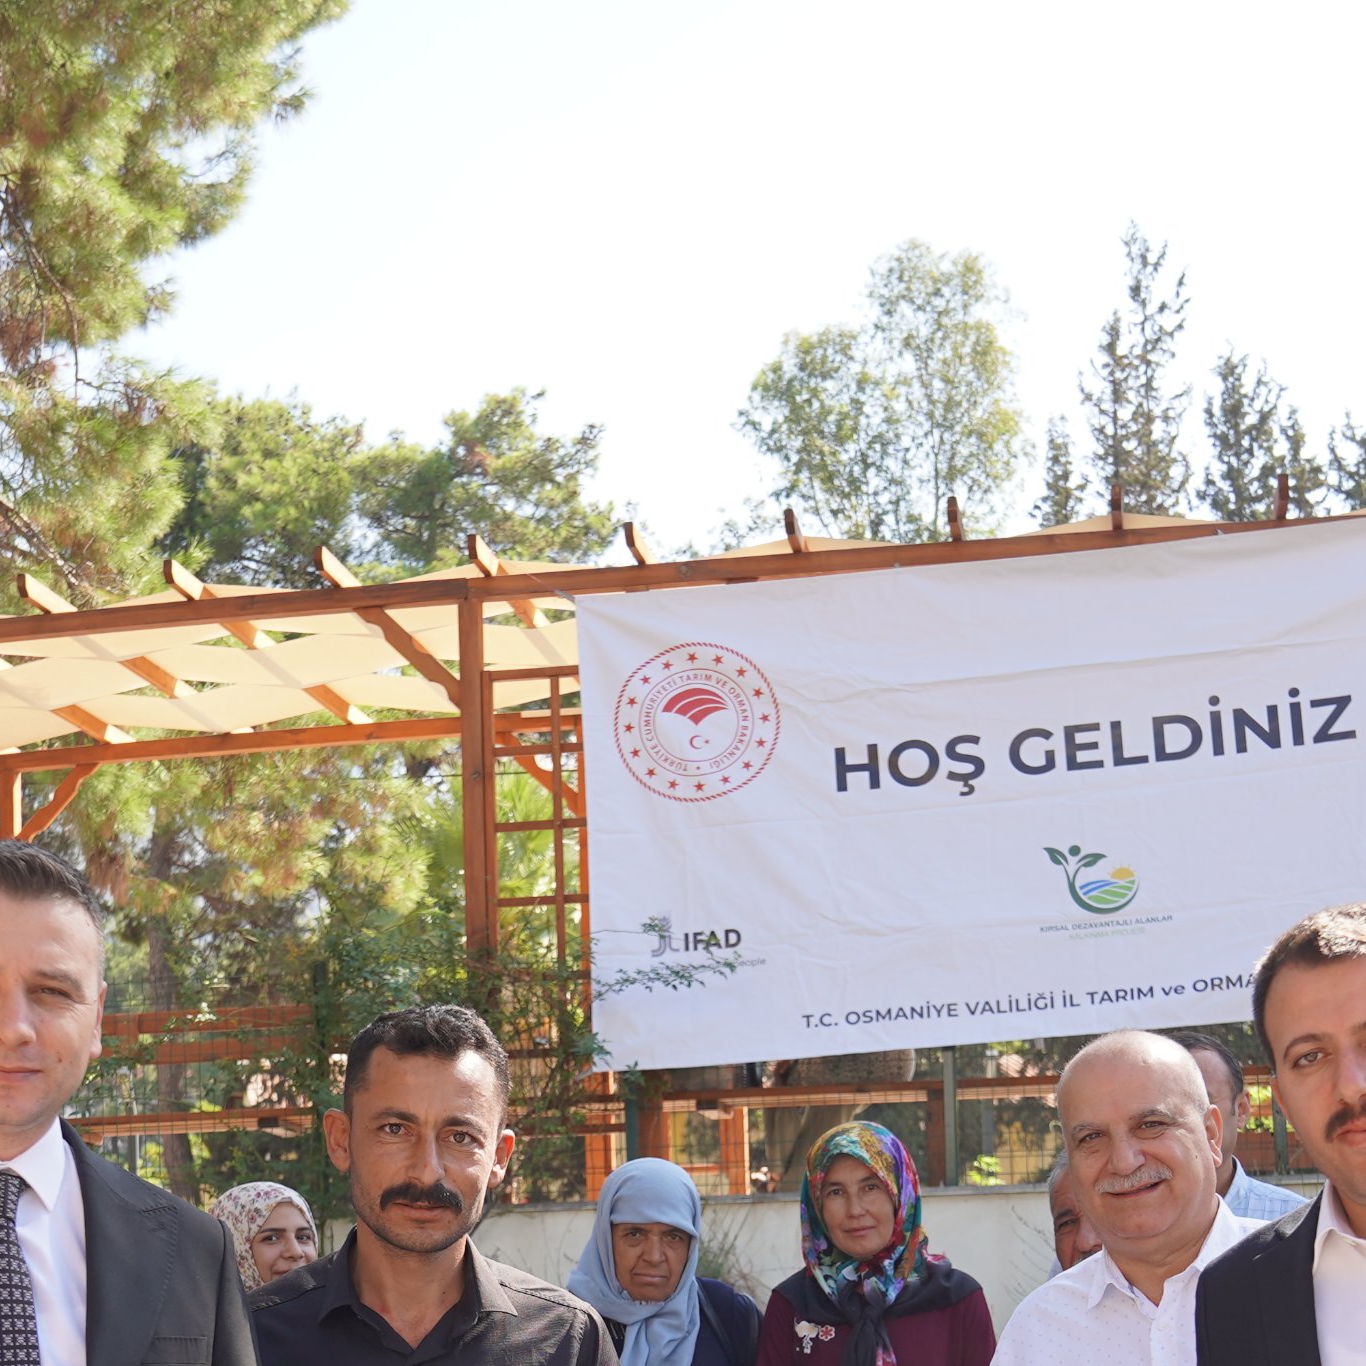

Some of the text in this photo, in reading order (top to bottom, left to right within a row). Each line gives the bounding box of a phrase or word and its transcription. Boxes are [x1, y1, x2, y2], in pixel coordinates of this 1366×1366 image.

[678, 673, 713, 683] TARIM
[715, 675, 728, 689] VE
[728, 686, 749, 722] ORMAN
[835, 687, 1357, 796] HOŞ GELDİNİZ
[684, 928, 742, 952] IFAD
[1039, 914, 1173, 932] KIRSAL DEZAVANTAJLI ALANLAR
[802, 973, 1256, 1029] T.C. OSMANİYE VALİLİĞİ İL TARIM ve ORMA
